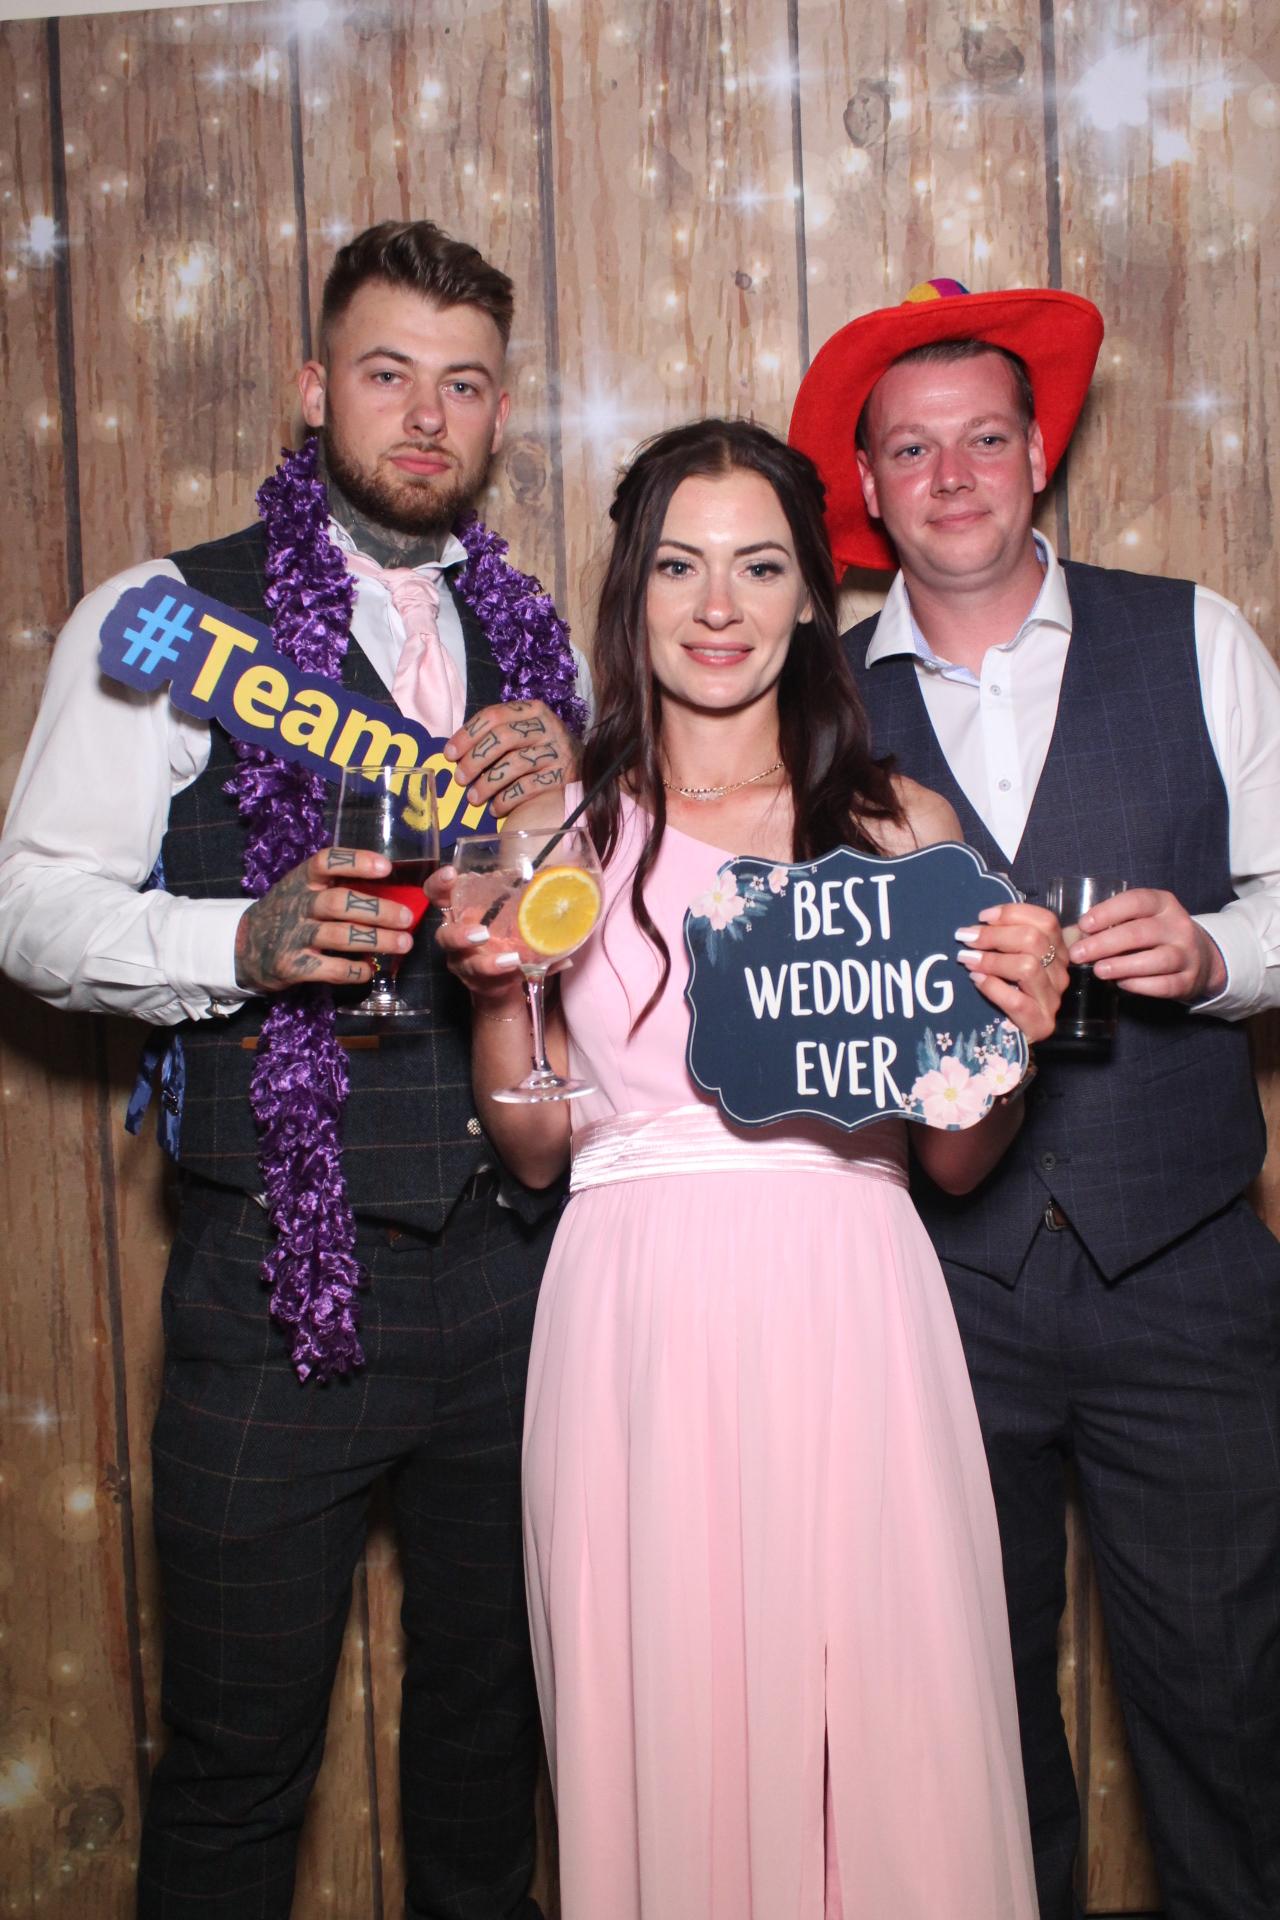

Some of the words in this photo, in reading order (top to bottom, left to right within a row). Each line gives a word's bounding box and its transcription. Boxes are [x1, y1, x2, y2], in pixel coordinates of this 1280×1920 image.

[122, 595, 504, 834] #Teamg
[793, 874, 896, 947] BEST
[744, 953, 955, 1020] WEDDING
[795, 1036, 902, 1109] EVER
